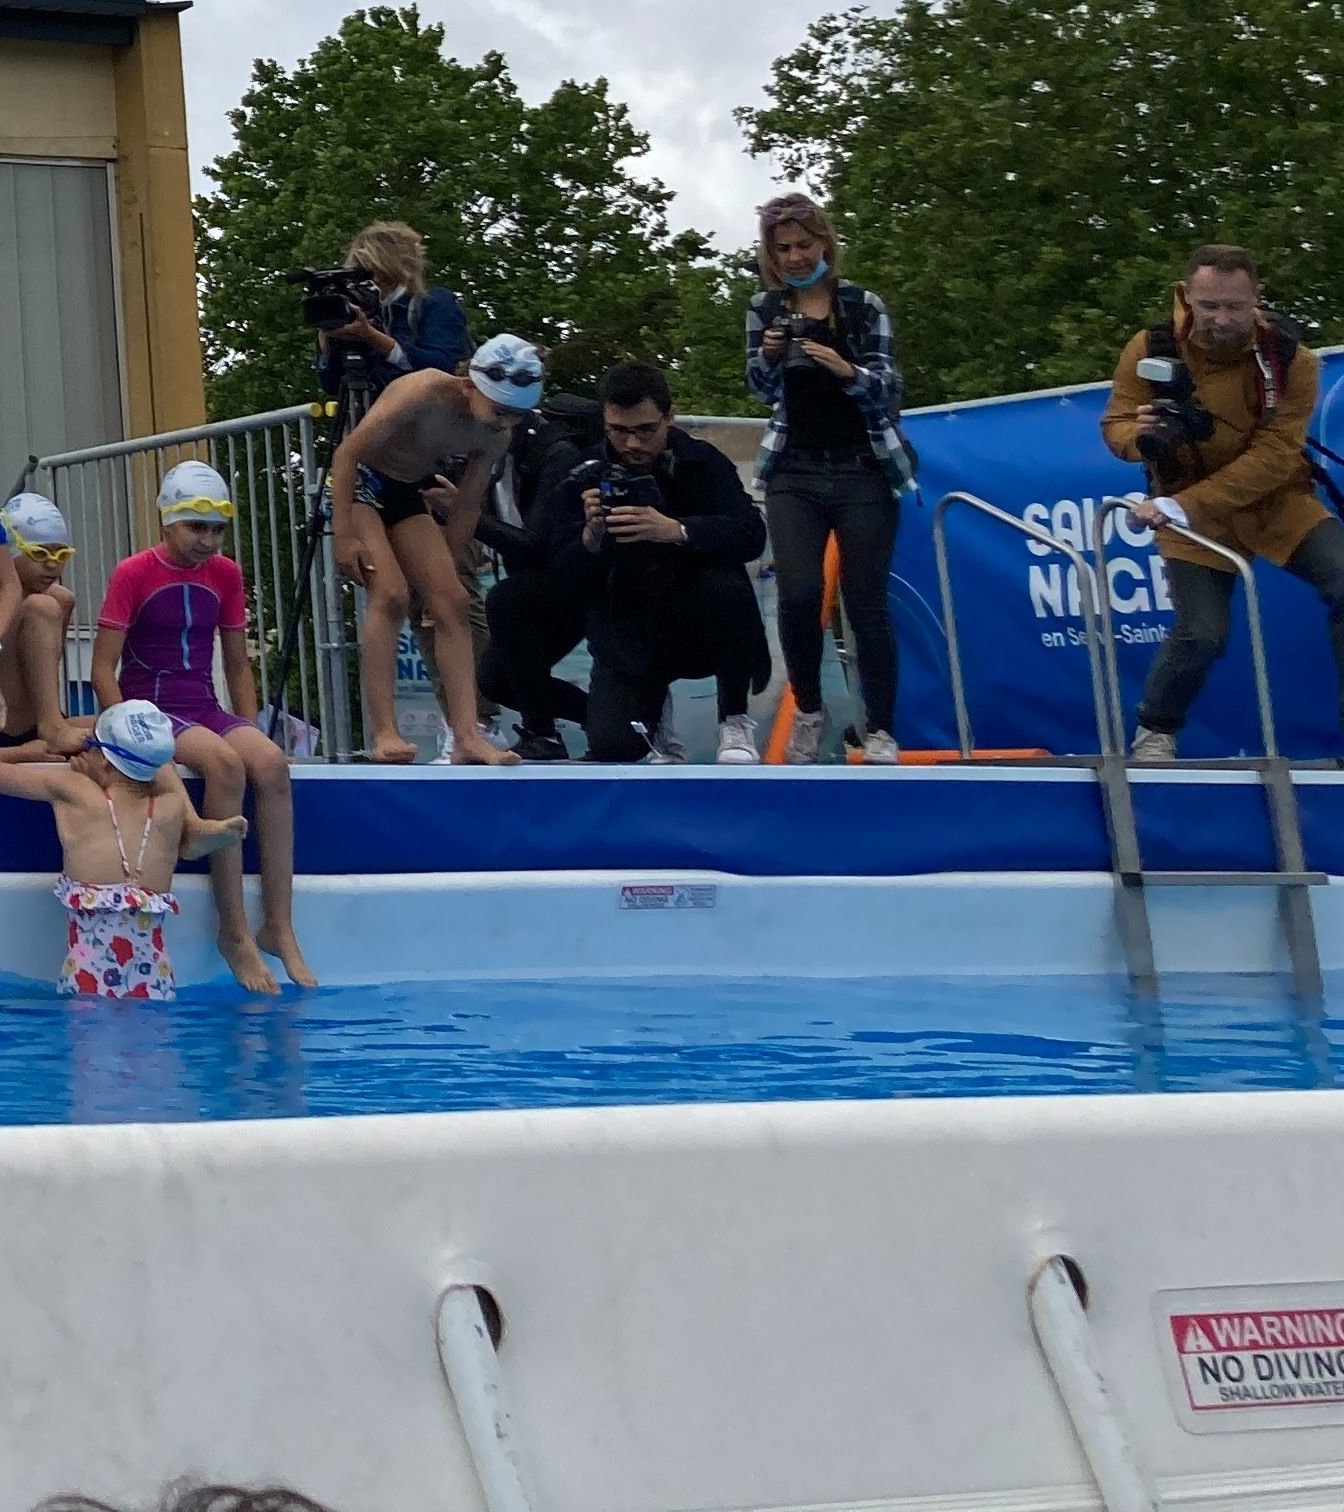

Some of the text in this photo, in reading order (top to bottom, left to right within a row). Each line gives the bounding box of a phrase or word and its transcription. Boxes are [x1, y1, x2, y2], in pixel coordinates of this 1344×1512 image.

[1041, 631, 1066, 648] en
[1197, 1354, 1244, 1385] NO
[1220, 1383, 1297, 1403] SHALLOW
